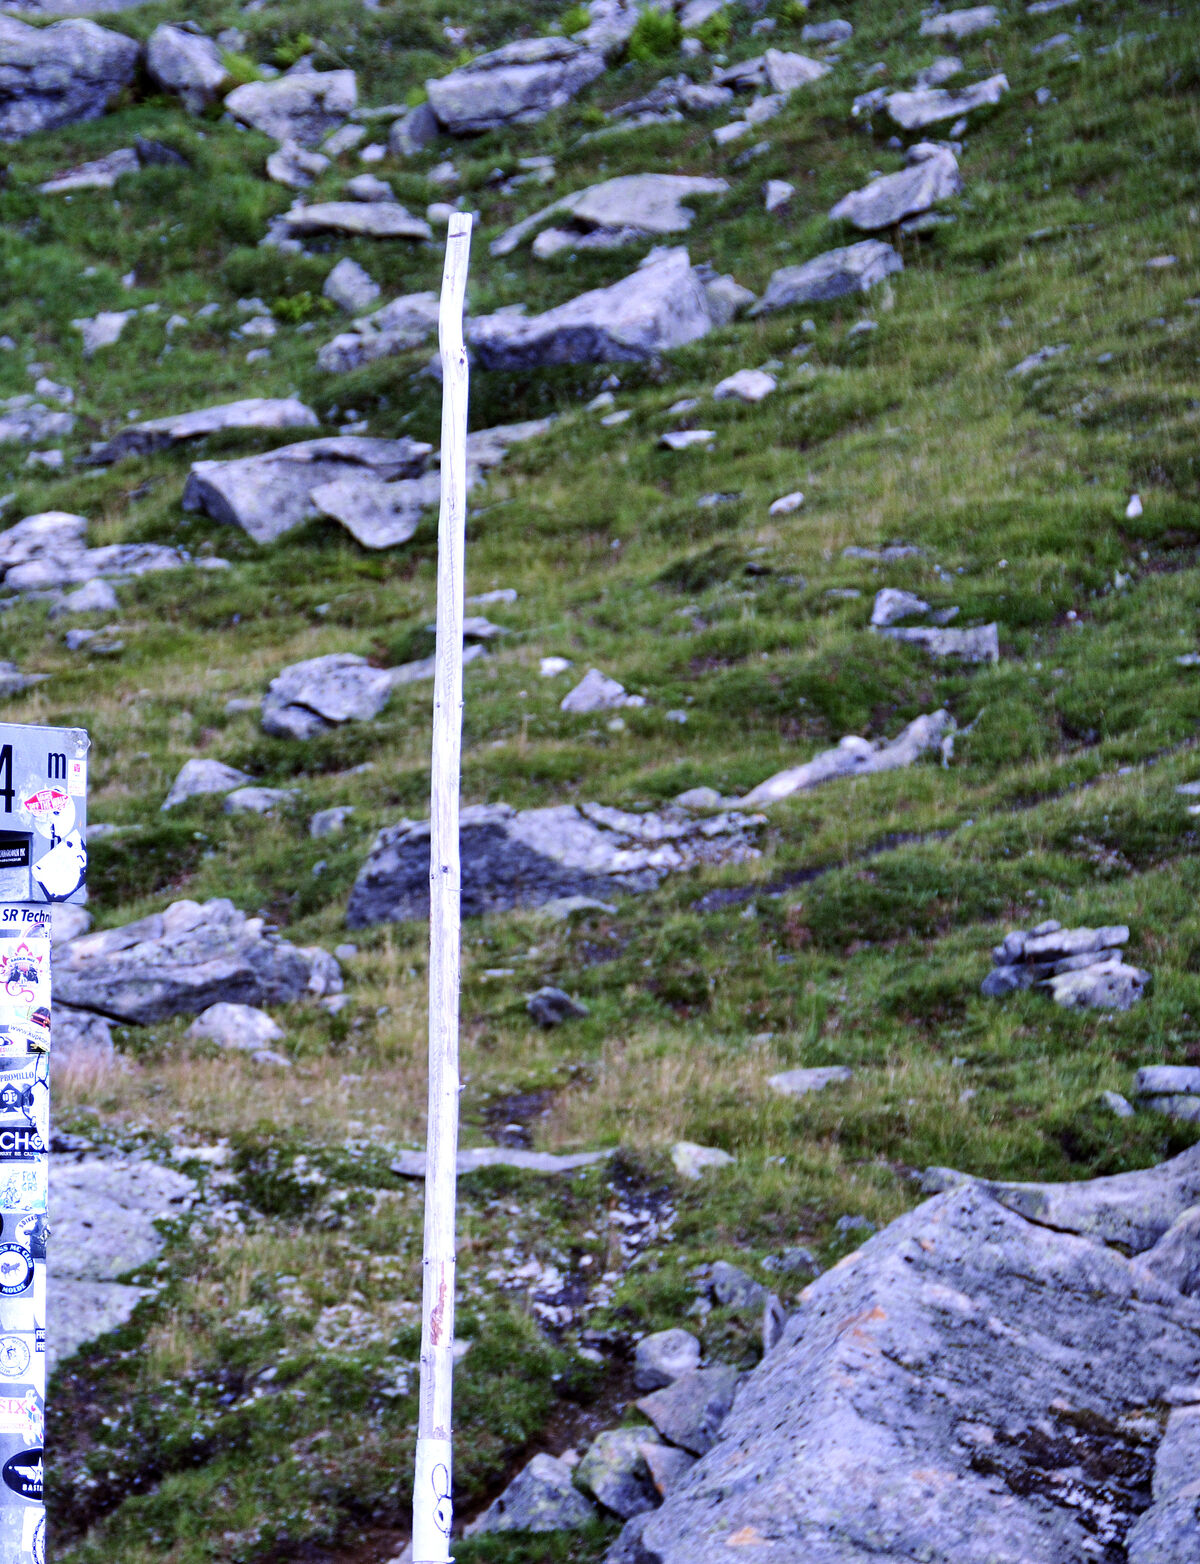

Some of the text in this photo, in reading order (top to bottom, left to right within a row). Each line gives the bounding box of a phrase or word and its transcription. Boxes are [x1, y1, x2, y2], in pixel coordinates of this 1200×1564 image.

[47, 752, 66, 779] m
[2, 908, 19, 922] SR
[0, 1071, 34, 1083] PROMILLO
[9, 1244, 22, 1253] MC
[21, 1250, 34, 1269] CLUB
[1, 1283, 27, 1294] MOLDE
